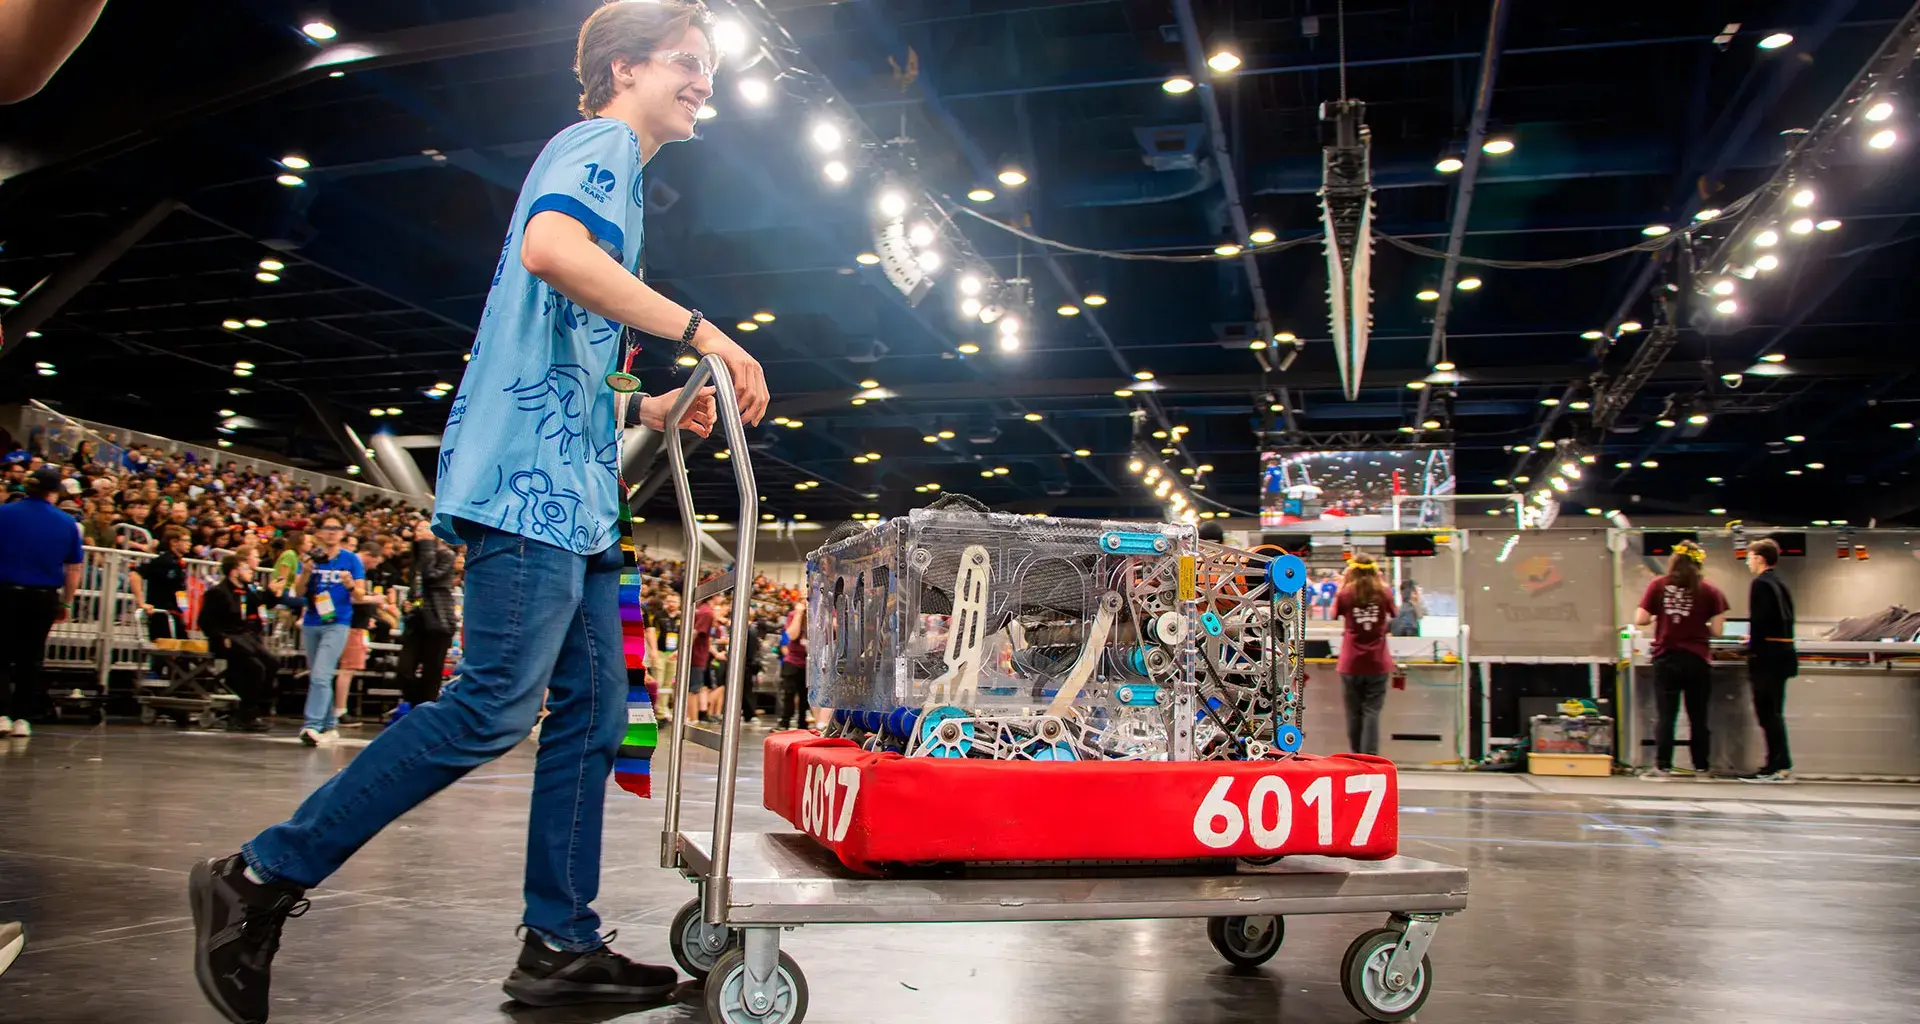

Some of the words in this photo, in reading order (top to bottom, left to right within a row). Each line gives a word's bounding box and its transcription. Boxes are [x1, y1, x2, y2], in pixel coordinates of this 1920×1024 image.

[580, 183, 605, 204] YEARS
[584, 163, 616, 193] 10
[802, 764, 861, 842] 6017
[1193, 773, 1387, 850] 6017
